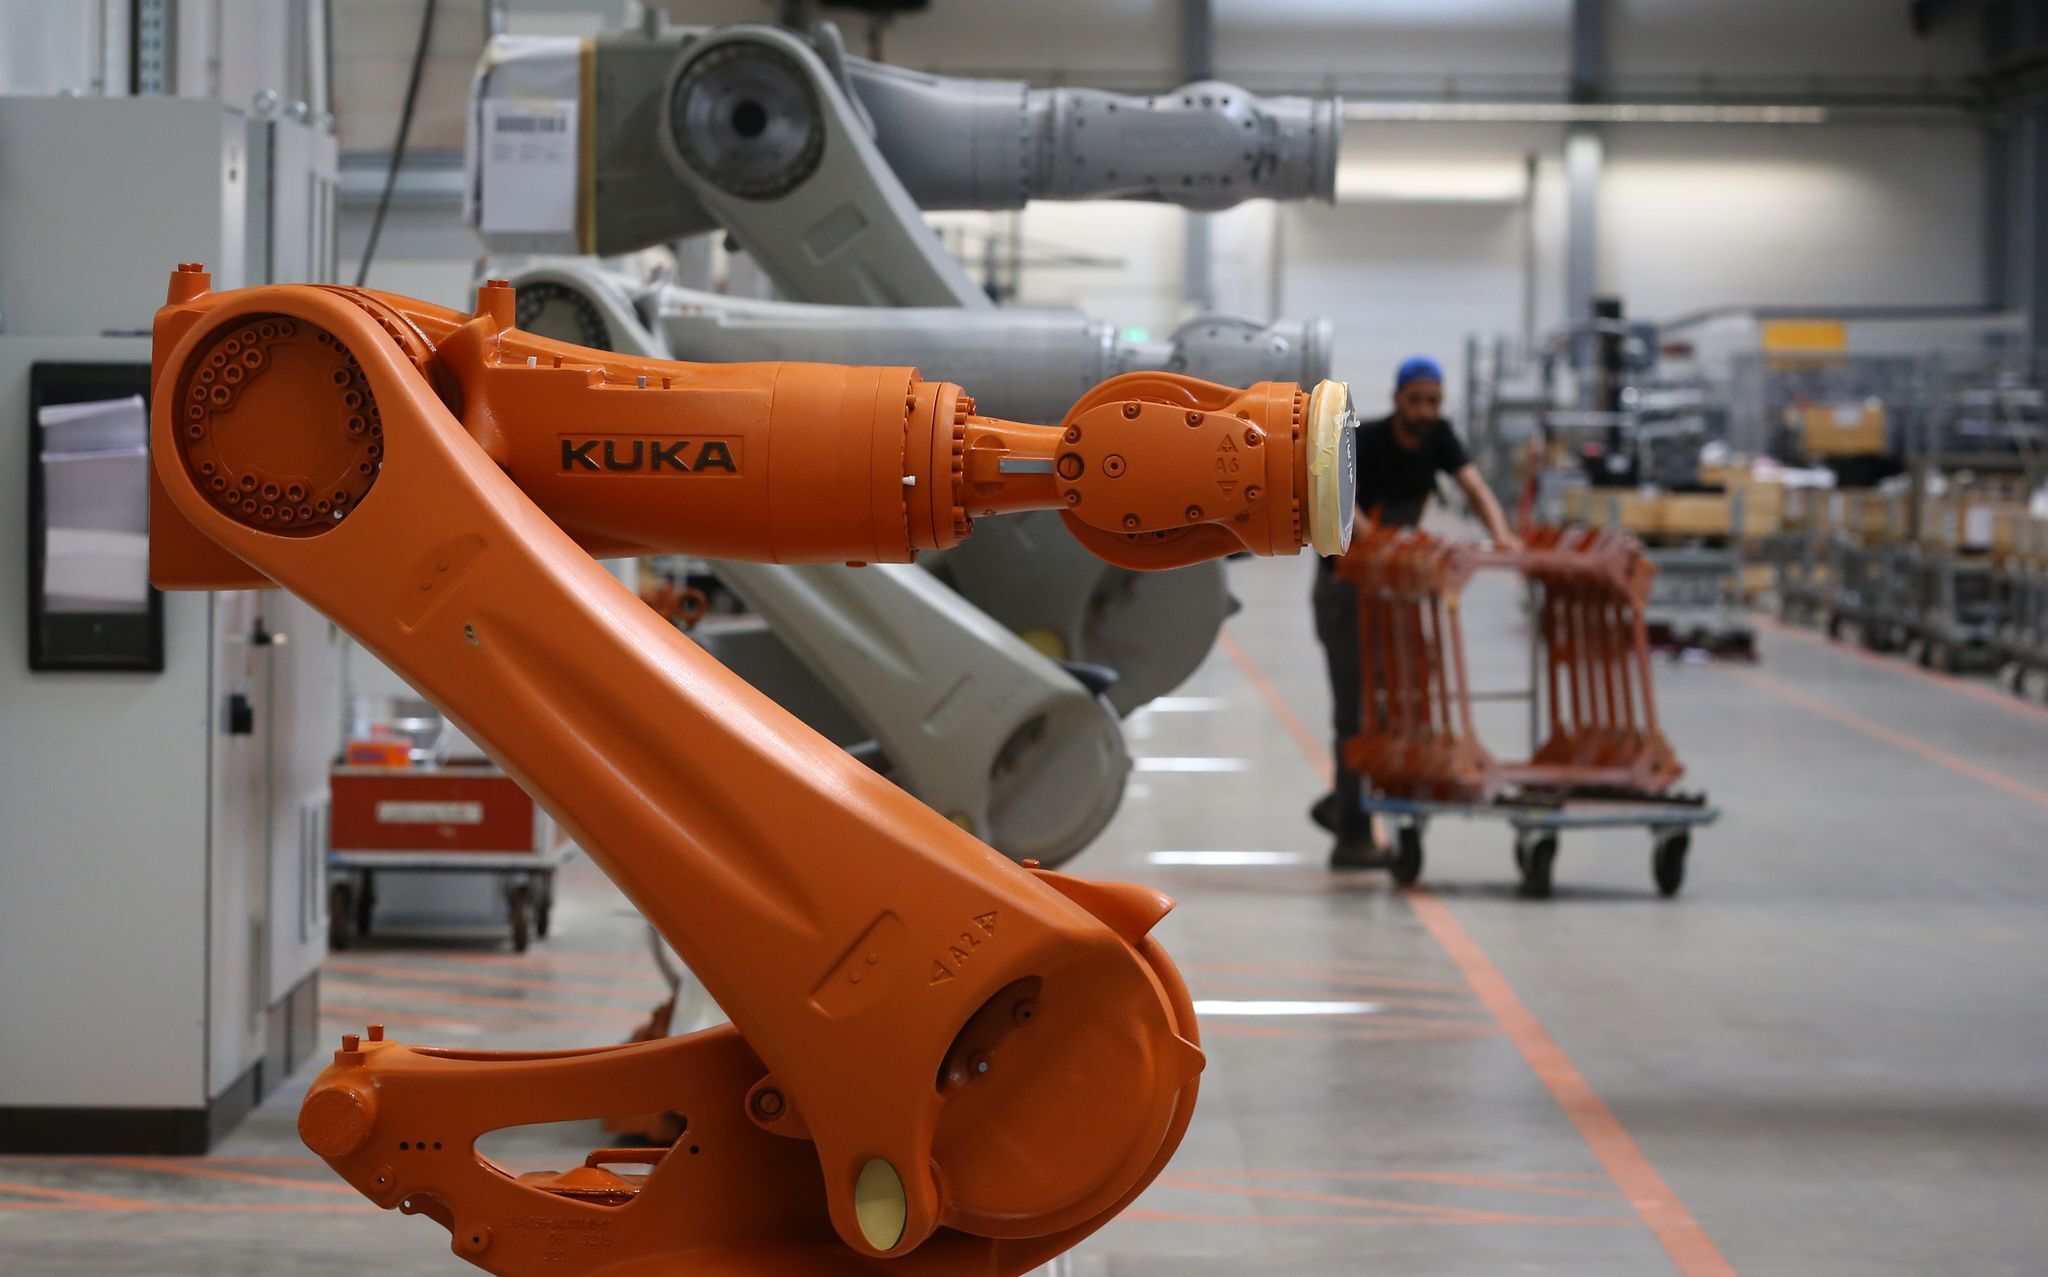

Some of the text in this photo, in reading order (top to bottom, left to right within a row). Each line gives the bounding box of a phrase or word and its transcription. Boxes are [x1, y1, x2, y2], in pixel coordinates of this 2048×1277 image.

[561, 439, 737, 472] KUKA
[1215, 457, 1240, 474] A6
[948, 932, 981, 967] A2
